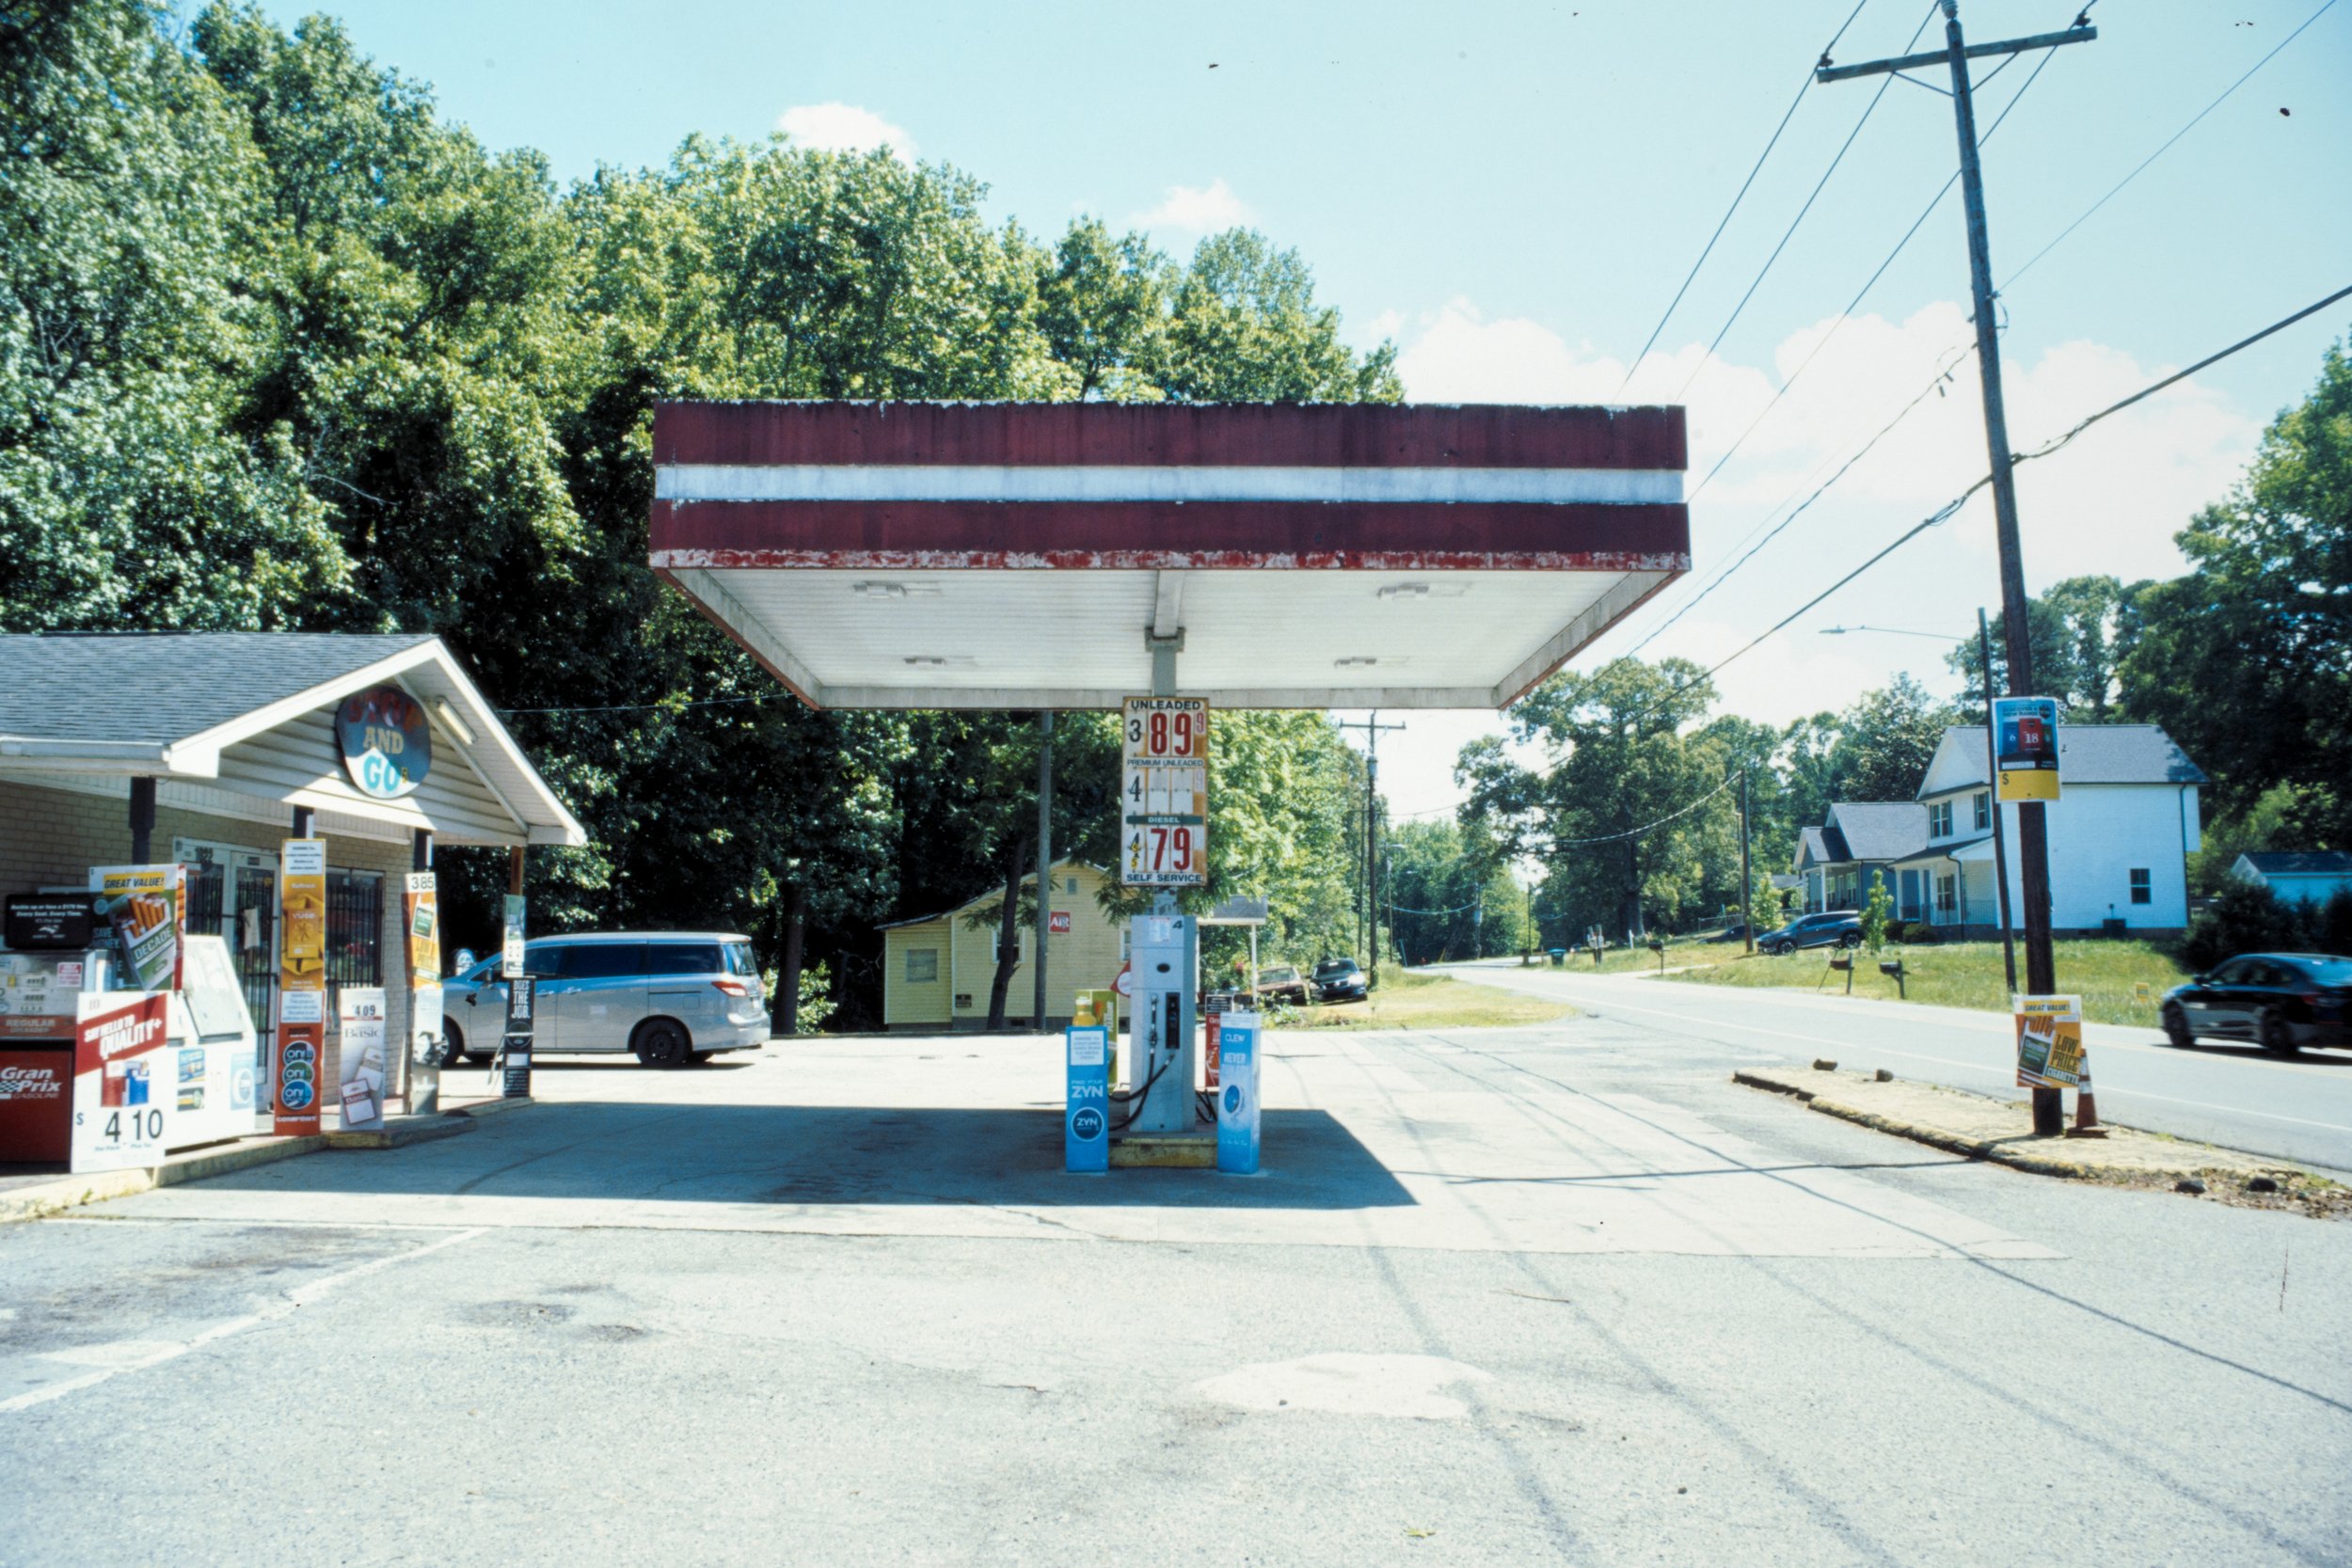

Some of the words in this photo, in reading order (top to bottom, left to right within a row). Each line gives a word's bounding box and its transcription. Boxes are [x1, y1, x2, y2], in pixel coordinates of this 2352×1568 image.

[1131, 701, 1200, 709] UNLEADED
[363, 726, 404, 754] AND
[2025, 733, 2039, 743] 18
[363, 754, 402, 792] GO
[2002, 773, 2010, 785] $
[1129, 775, 1141, 801] 4
[104, 879, 132, 889] GREAT
[133, 877, 166, 887] VALUE!
[411, 876, 435, 889] 385
[1126, 874, 1152, 882] SELF
[1157, 874, 1201, 882] SERVICE
[1172, 920, 1183, 929] 4
[134, 927, 173, 960] DECADE
[514, 980, 530, 990] DOES
[514, 990, 529, 1005] THE
[511, 1005, 531, 1019] JOB.
[99, 1019, 123, 1037] HELLO
[123, 1014, 135, 1029] TO
[344, 1027, 381, 1038] Basic
[2055, 1034, 2079, 1054] LOW
[2049, 1051, 2079, 1074] PRICE
[0, 1067, 54, 1080] Gran
[17, 1079, 62, 1092] Prix
[1071, 1085, 1104, 1098] ZYN
[75, 1112, 84, 1126] $
[1076, 1117, 1098, 1126] ZYN
